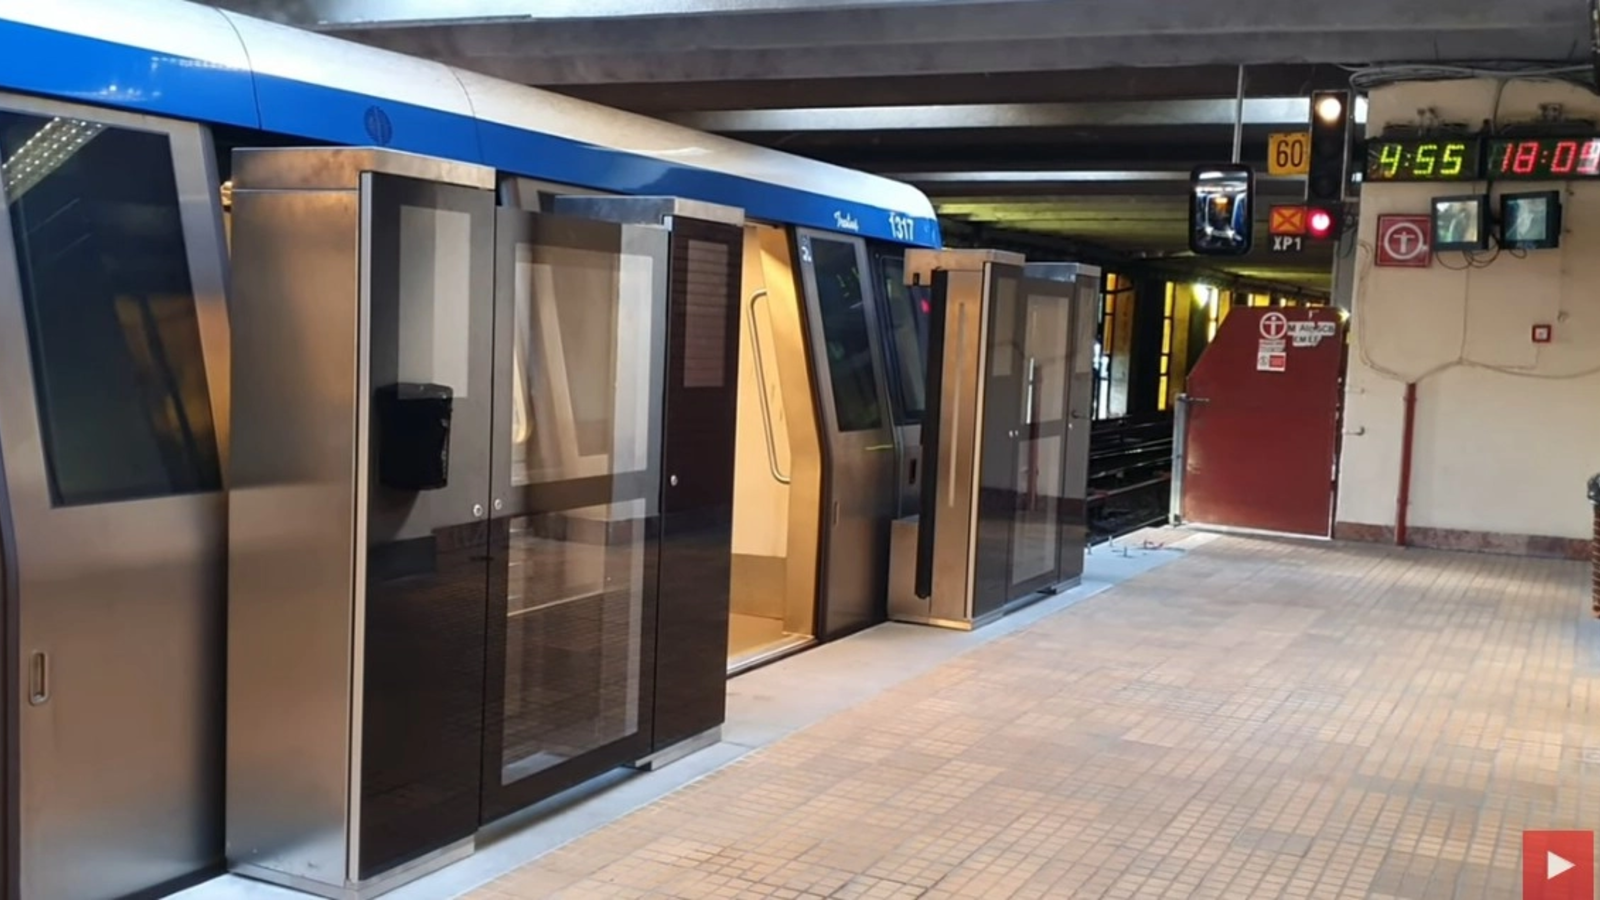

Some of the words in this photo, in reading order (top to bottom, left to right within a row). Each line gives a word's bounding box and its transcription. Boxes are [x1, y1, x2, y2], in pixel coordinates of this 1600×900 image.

[1276, 139, 1303, 168] 60
[889, 212, 914, 241] 1317
[1273, 236, 1301, 251] XP1
